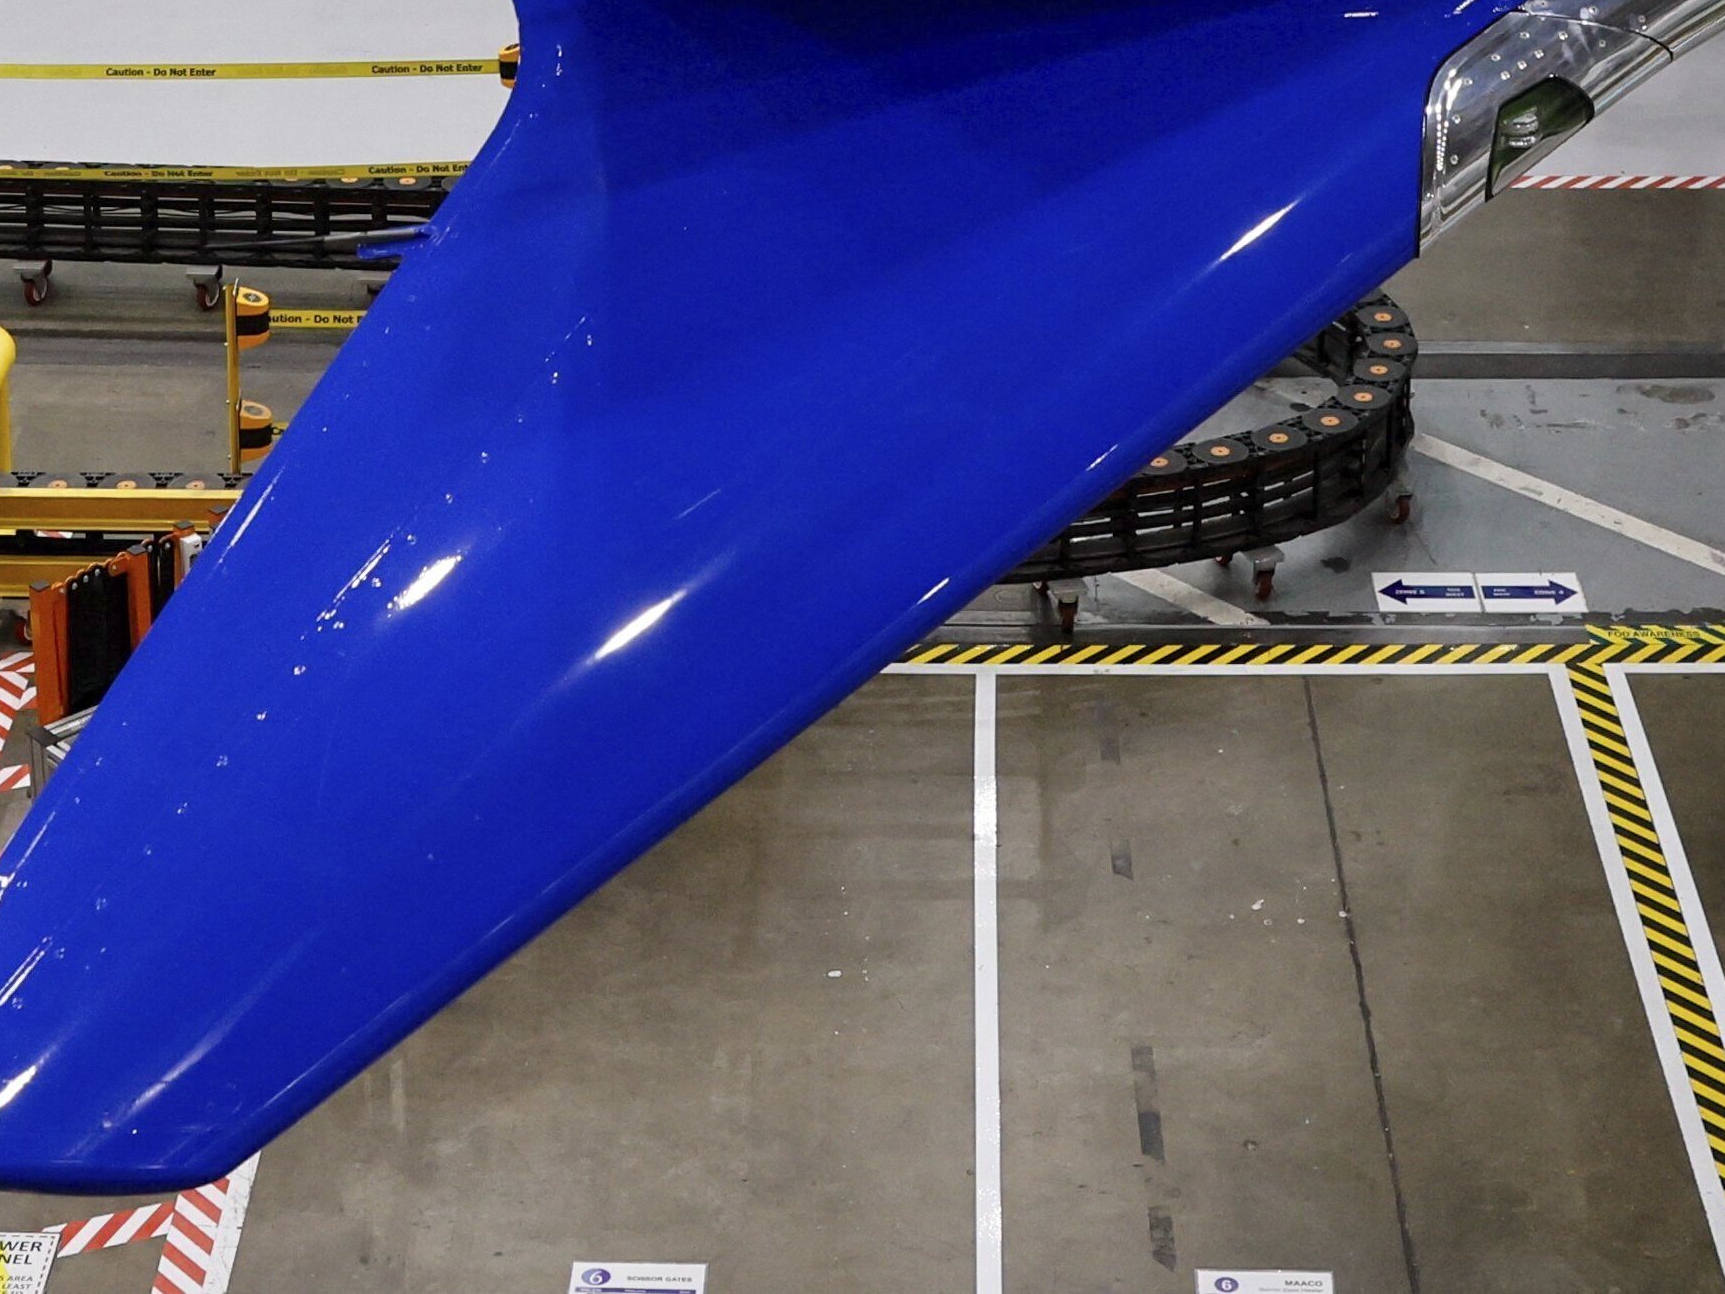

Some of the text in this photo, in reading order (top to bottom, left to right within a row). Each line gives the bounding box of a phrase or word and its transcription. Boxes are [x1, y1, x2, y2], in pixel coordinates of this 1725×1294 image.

[106, 67, 216, 77] Caution Do Not Enter
[372, 63, 483, 75] Caution Do Not Enter
[368, 163, 471, 174] Caution Do Not Ent
[314, 314, 329, 323] Do
[332, 314, 353, 323] Not
[1608, 630, 1701, 638] FOD AWARENESS
[589, 1270, 603, 1285] 6
